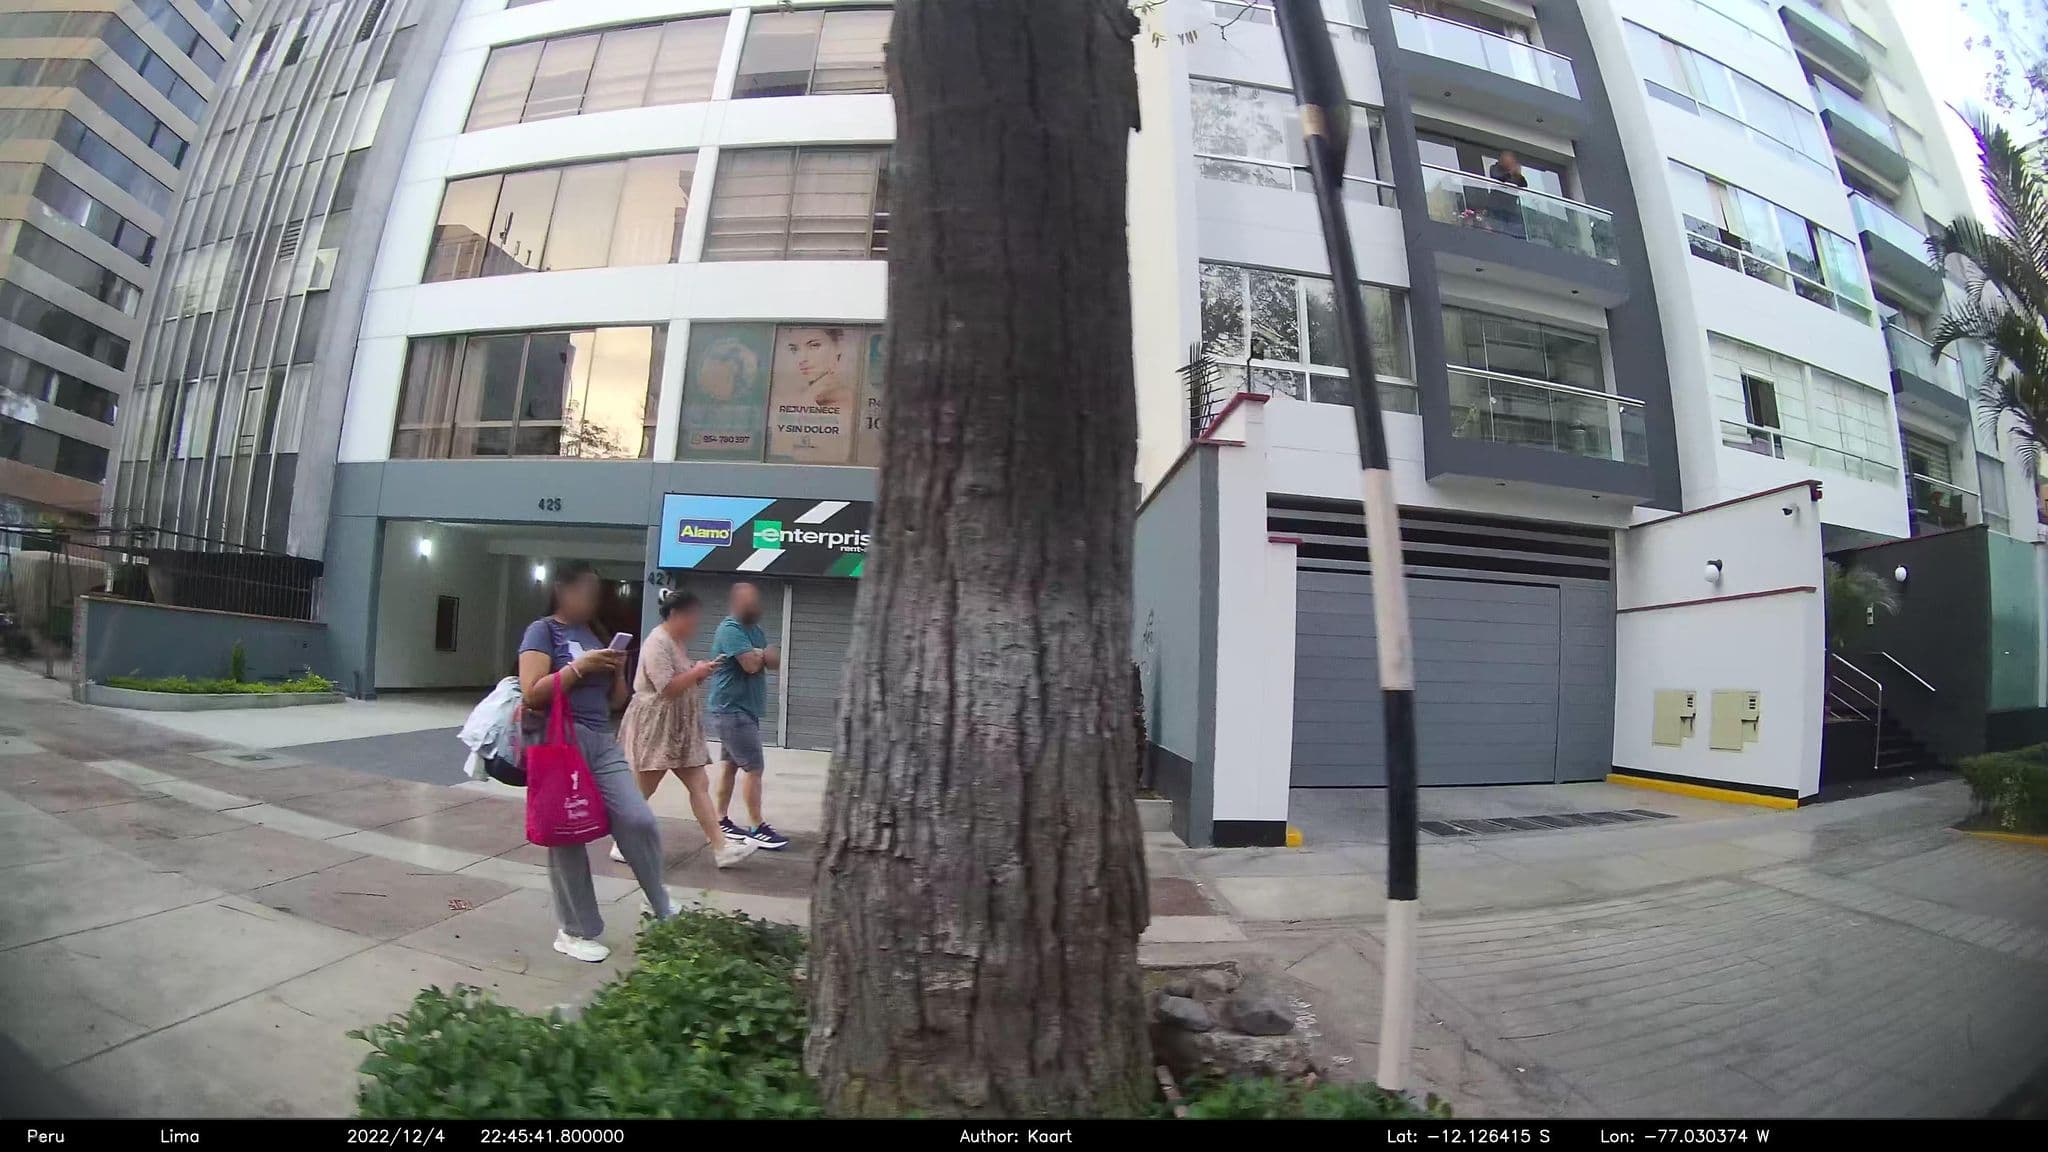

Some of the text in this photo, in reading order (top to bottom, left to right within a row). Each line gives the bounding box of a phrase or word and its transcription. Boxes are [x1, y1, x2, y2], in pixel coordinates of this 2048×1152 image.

[779, 405, 840, 414] REJUVENECE
[777, 424, 839, 434] Y SIN DOLOR
[538, 498, 562, 511] 425
[680, 525, 871, 549] Alamo enterpris
[648, 571, 673, 585] 427
